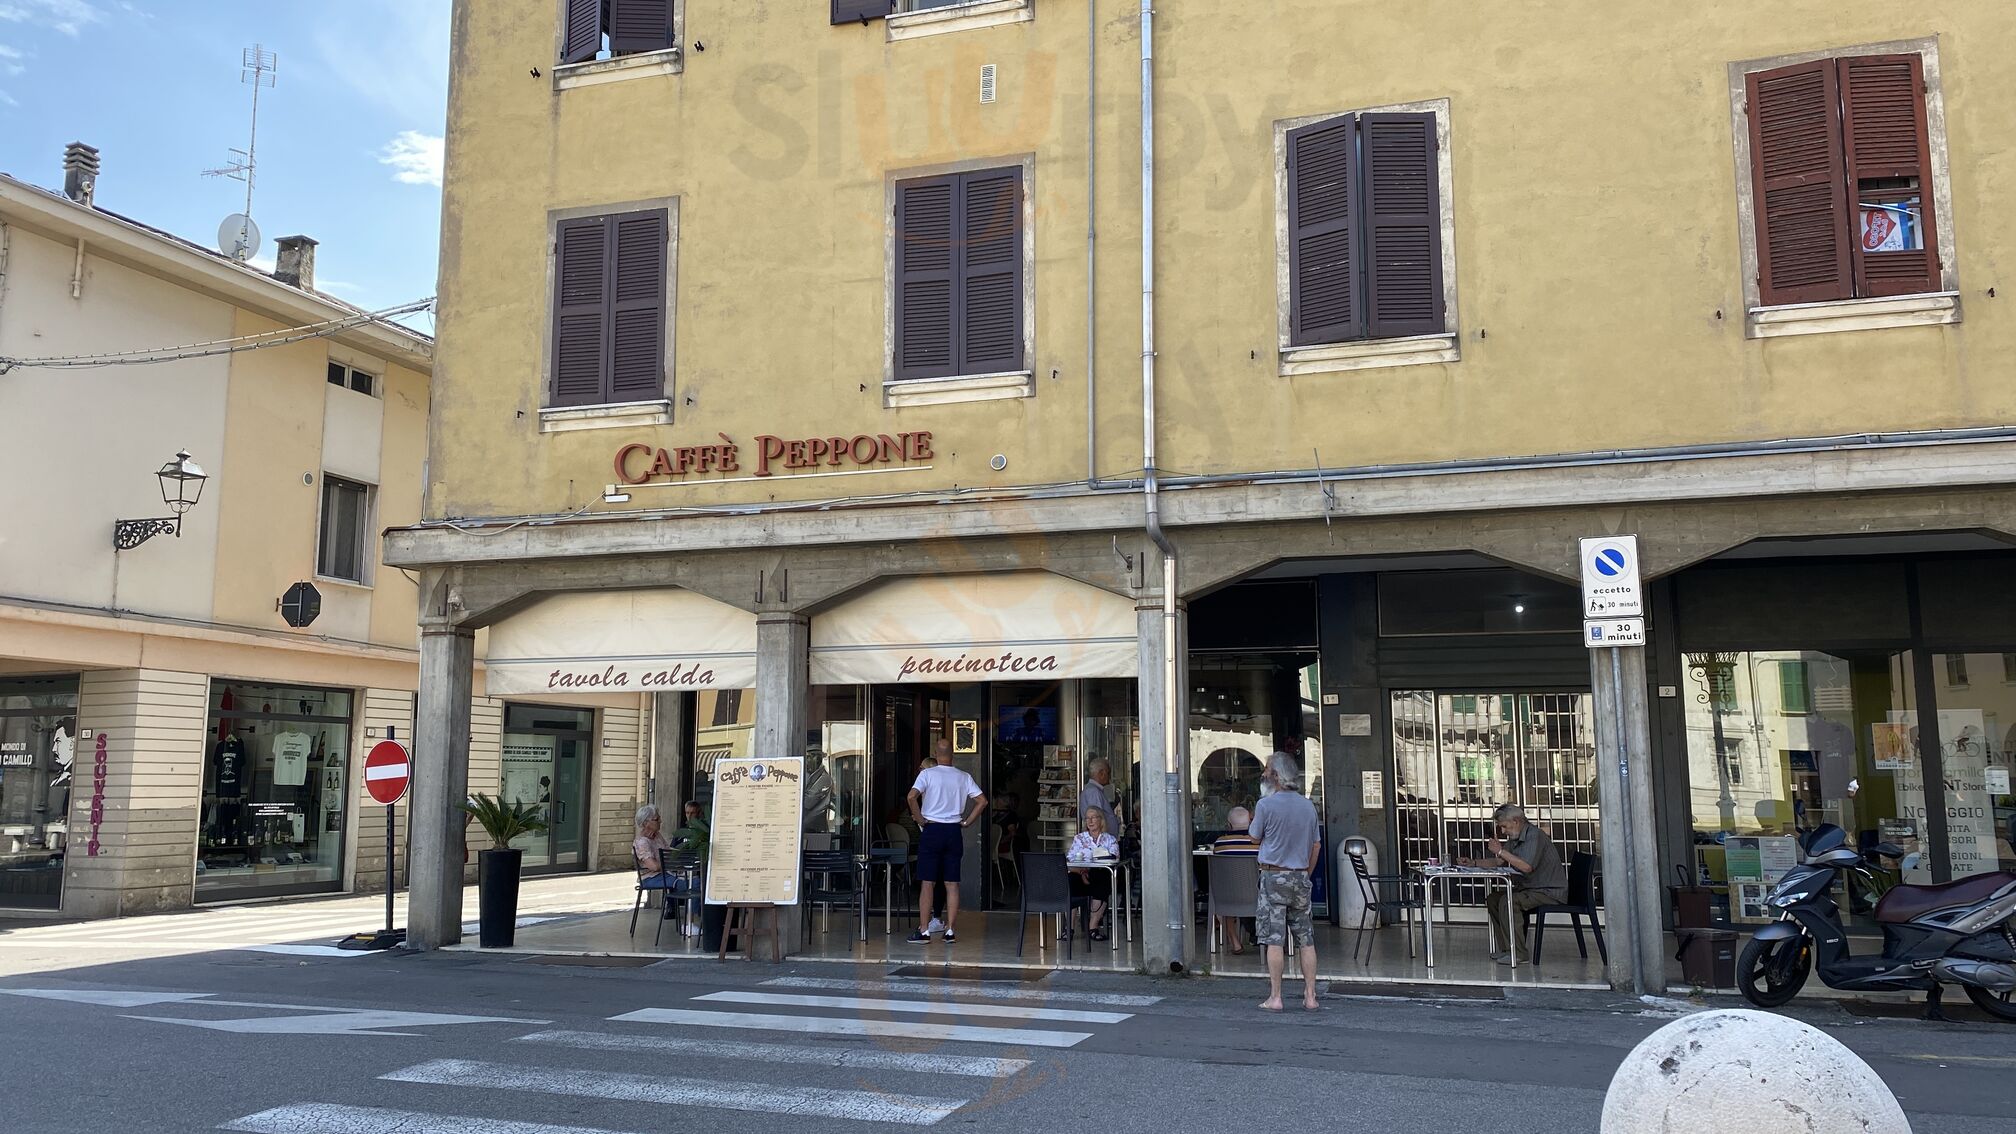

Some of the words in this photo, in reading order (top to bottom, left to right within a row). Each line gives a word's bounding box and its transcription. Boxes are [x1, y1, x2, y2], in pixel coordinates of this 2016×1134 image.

[614, 432, 739, 484] CAFFÈ
[754, 431, 934, 477] PEPPONE
[1593, 586, 1631, 594] eccetto
[1616, 624, 1631, 632] 30
[1607, 632, 1641, 641] minuti
[896, 650, 1059, 682] paninoteca
[547, 665, 628, 689] tavola
[640, 663, 717, 687] calda
[1664, 687, 1670, 695] 2
[88, 734, 107, 856] SOUVENIR
[1904, 806, 1984, 818] NOGGIO
